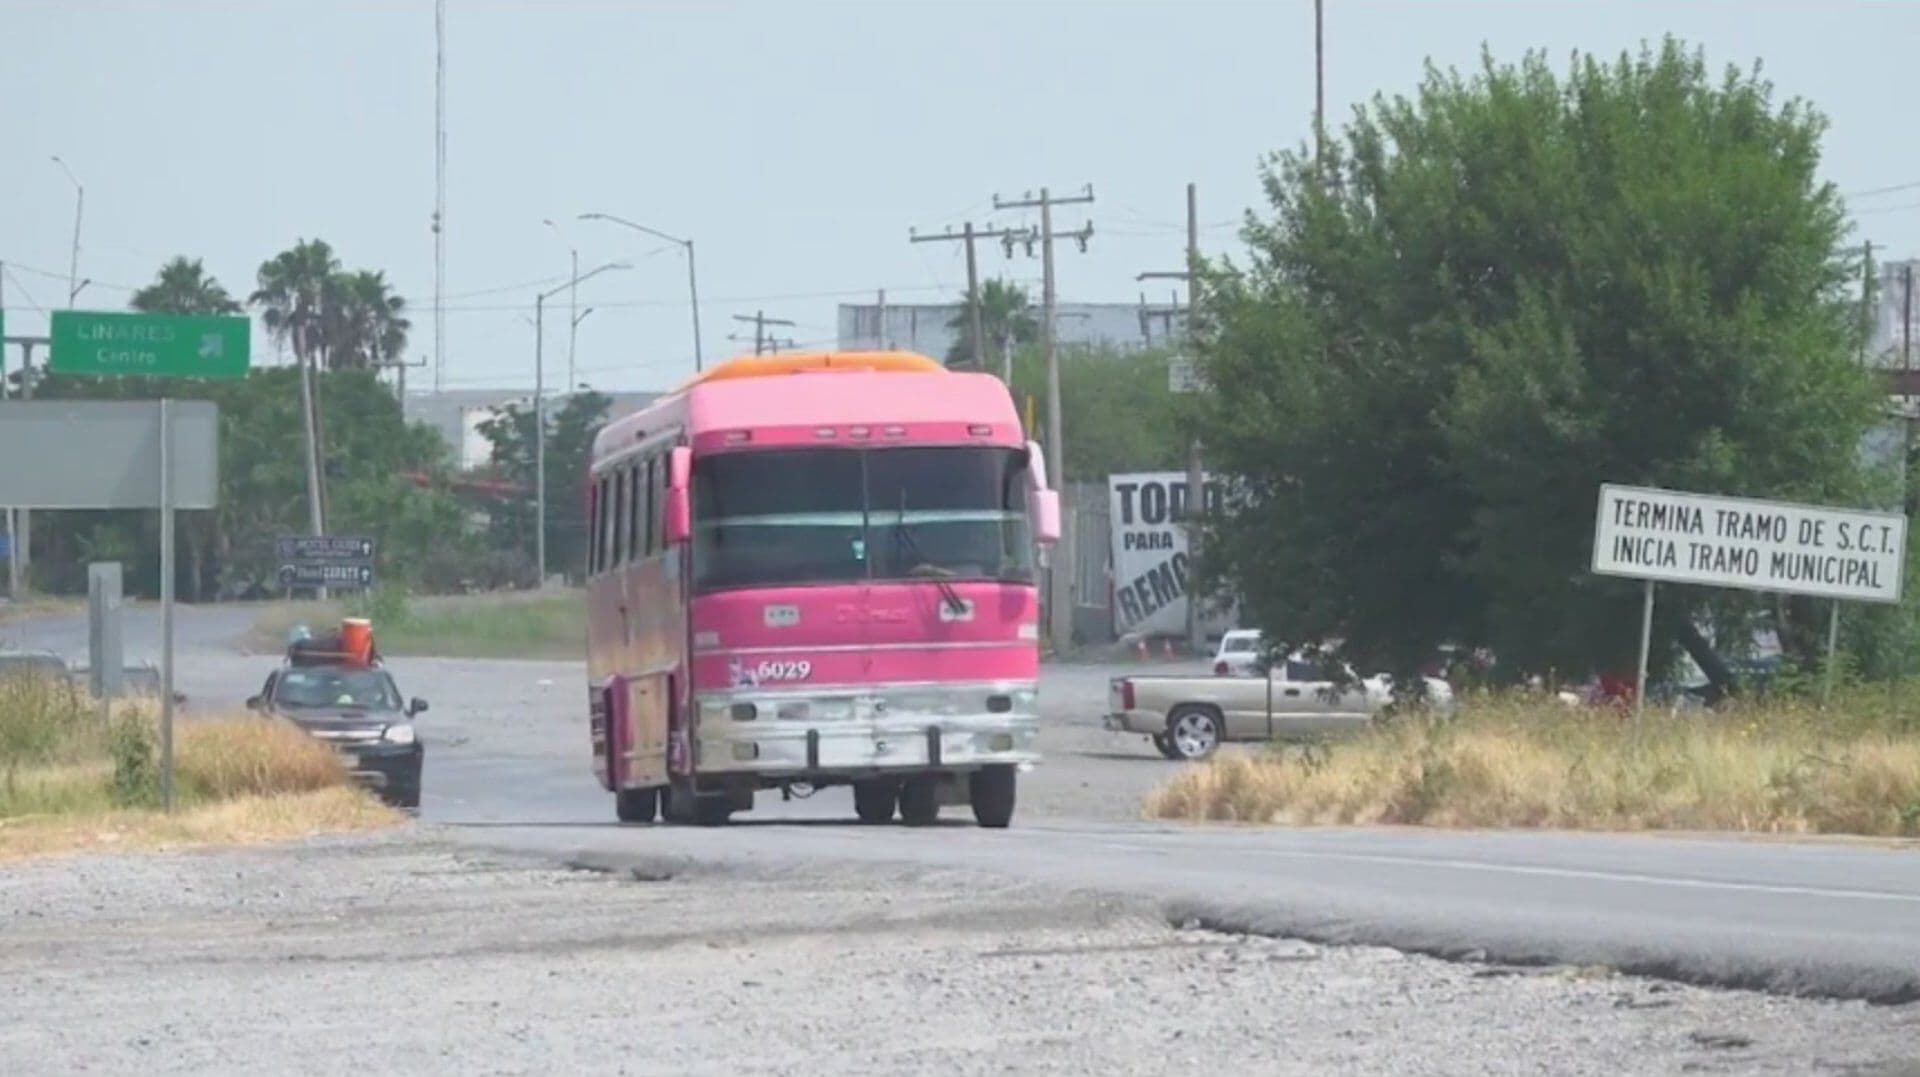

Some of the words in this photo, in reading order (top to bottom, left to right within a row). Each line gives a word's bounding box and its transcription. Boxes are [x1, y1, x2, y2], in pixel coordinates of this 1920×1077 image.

[76, 321, 176, 342] LINARES
[1613, 498, 1704, 535] TERMINA
[1715, 509, 1787, 544] TRAMO
[1798, 518, 1825, 547] DE
[1836, 521, 1895, 554] S.C.T.
[1124, 531, 1174, 551] PARA
[1612, 535, 1677, 568] INICIA
[1688, 542, 1759, 577] TRAMO
[1769, 551, 1883, 589] MUNICIPAL
[758, 660, 811, 679] 6029
